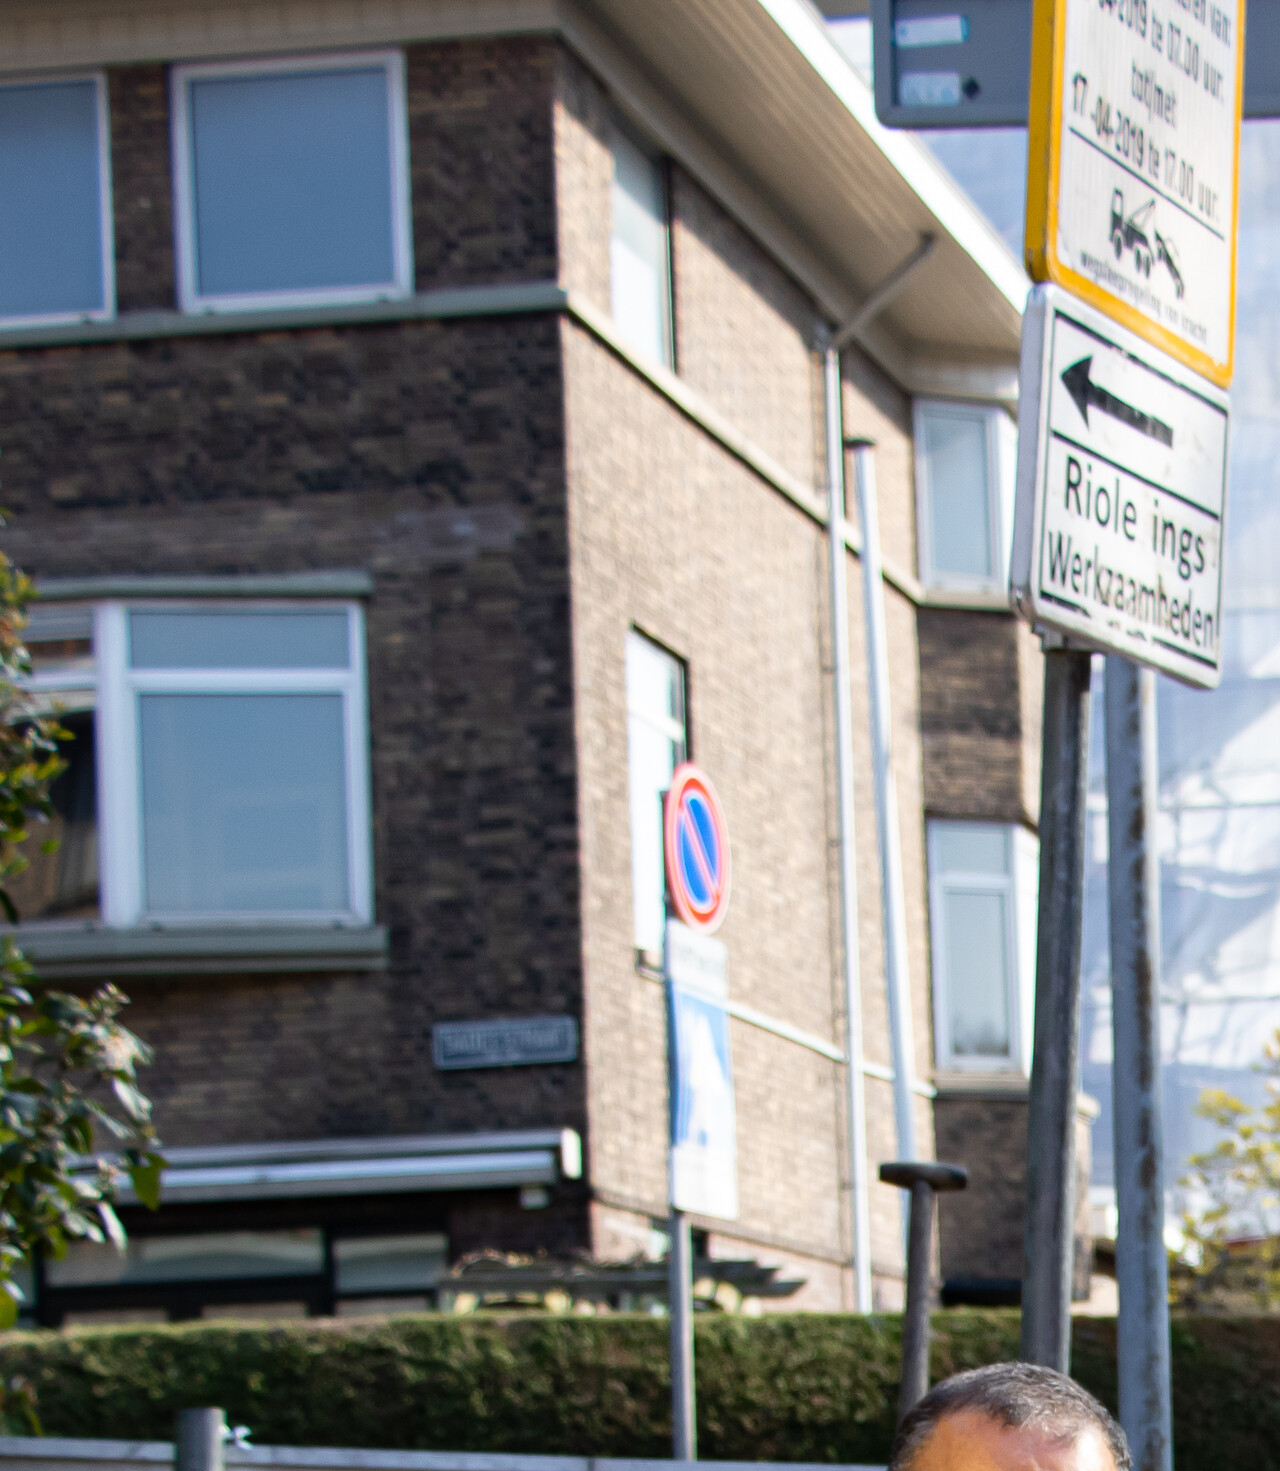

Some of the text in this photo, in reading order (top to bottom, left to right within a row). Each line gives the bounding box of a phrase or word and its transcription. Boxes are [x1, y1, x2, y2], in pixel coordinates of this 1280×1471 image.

[1151, 9, 1163, 53] te
[1168, 20, 1199, 82] 07.00
[1149, 136, 1160, 180] te
[1065, 454, 1137, 542] Riole
[1049, 530, 1214, 648] Werkzaamheden
